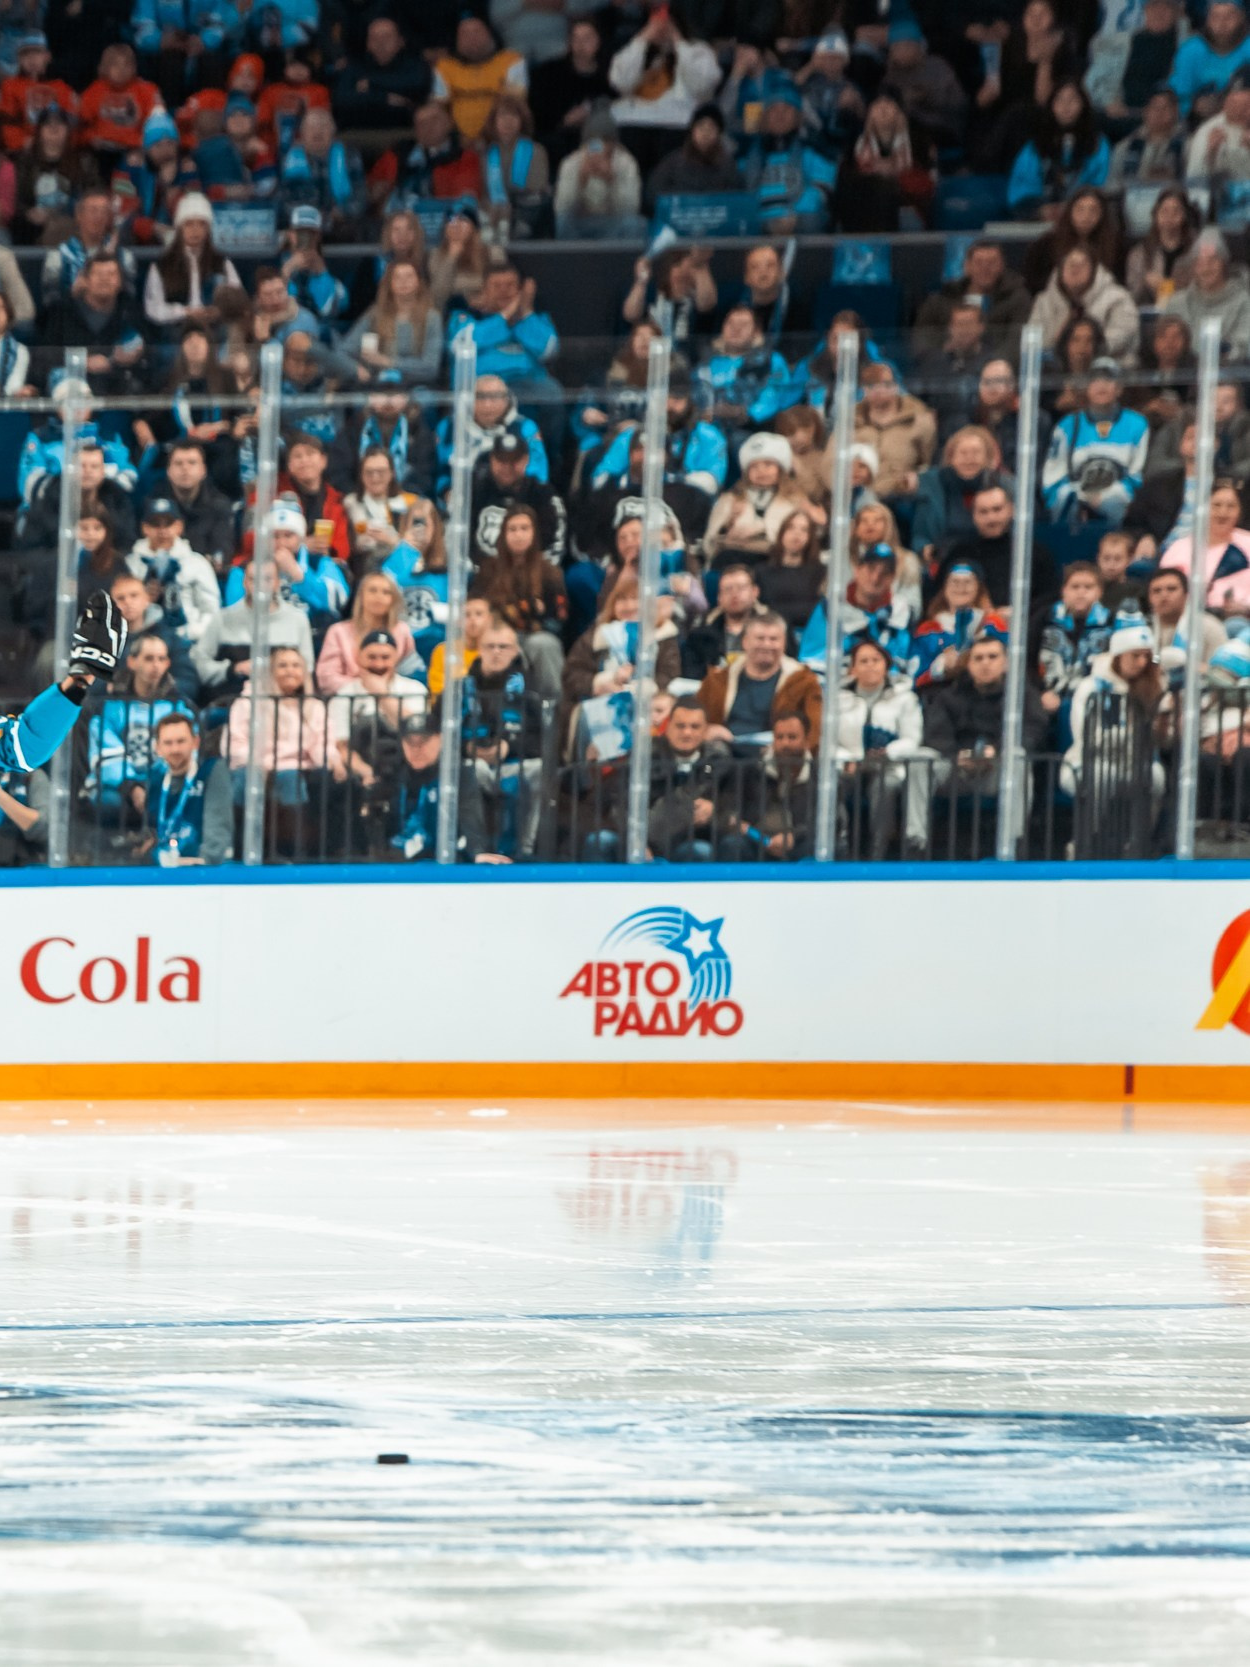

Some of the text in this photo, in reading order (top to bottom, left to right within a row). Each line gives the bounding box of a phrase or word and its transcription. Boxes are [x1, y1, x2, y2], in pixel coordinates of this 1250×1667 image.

[19, 936, 201, 1004] Cola
[558, 961, 681, 998] АВТО
[594, 1000, 744, 1037] РАДИО
